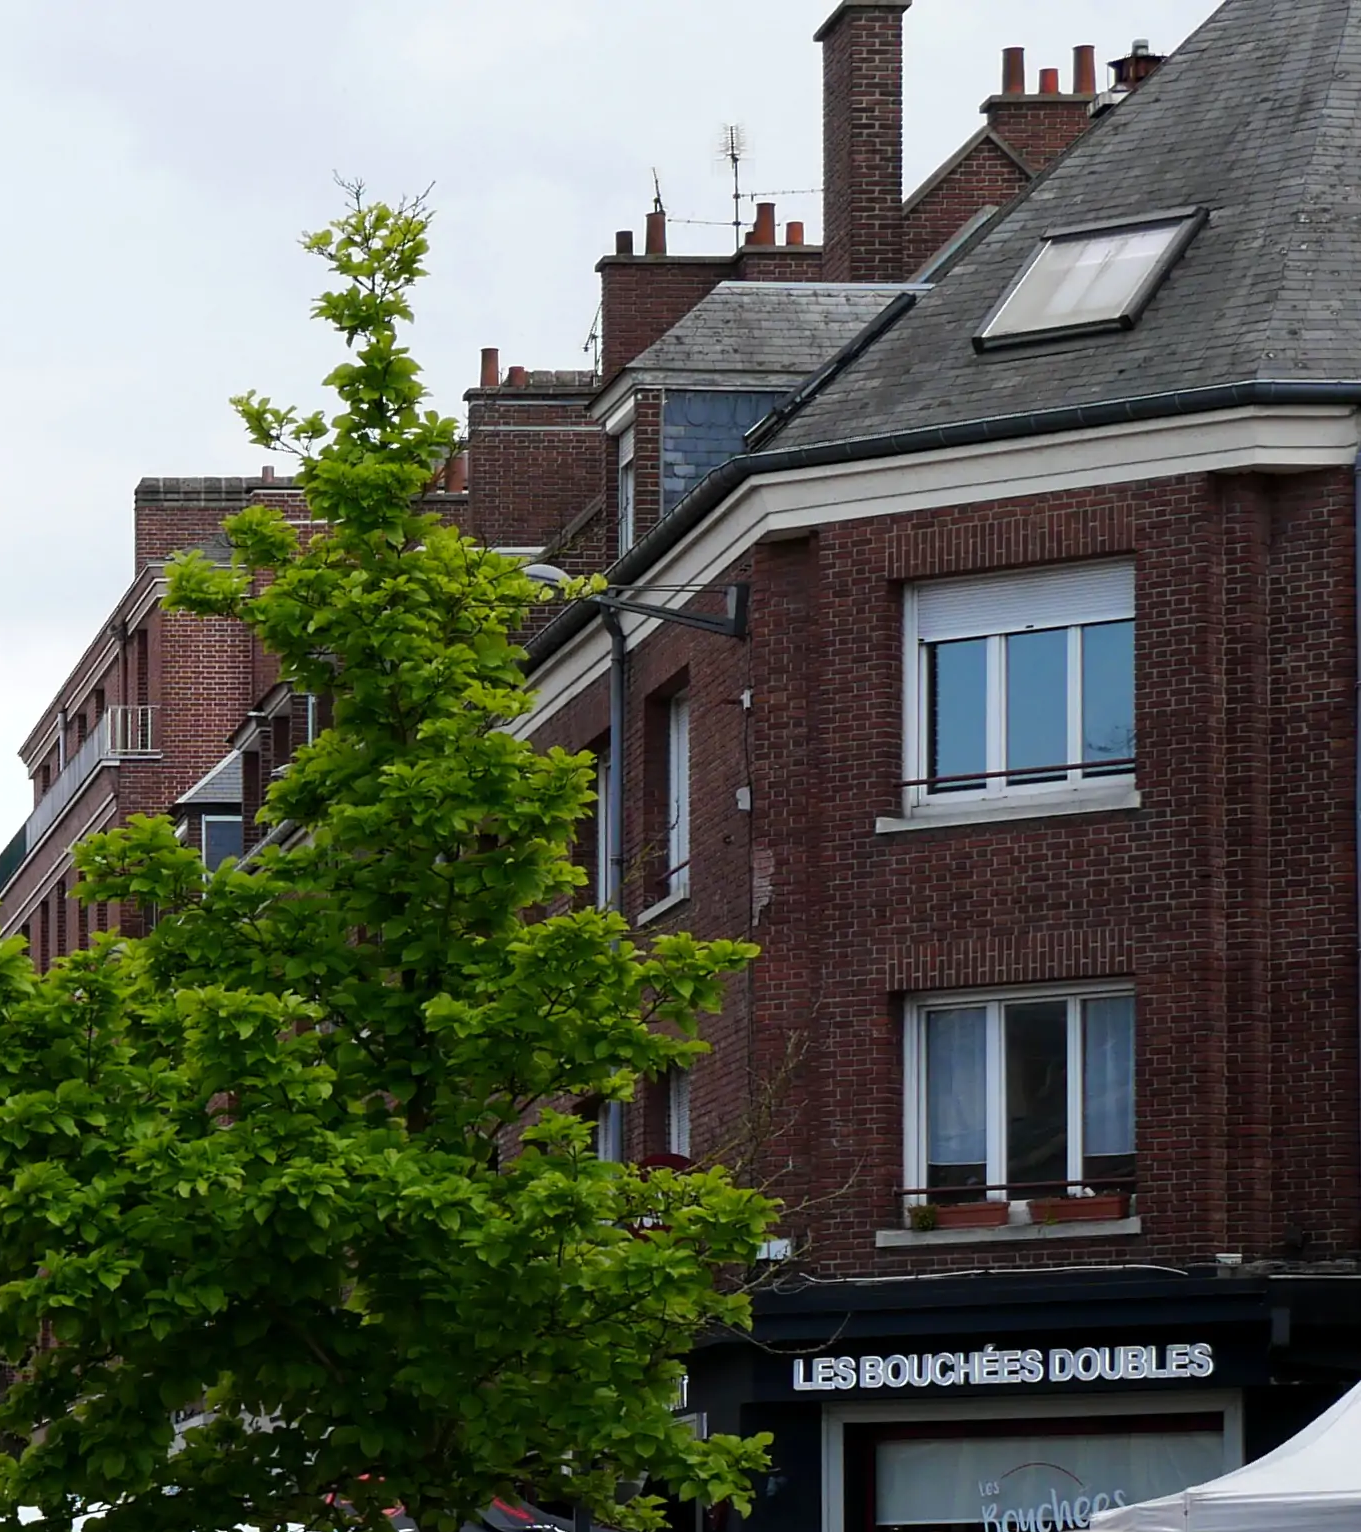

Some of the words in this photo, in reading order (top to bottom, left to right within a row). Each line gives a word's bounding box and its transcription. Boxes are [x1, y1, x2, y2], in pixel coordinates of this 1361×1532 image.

[793, 1356, 856, 1391] LES
[860, 1343, 1044, 1389] BOUCHÉES
[1048, 1342, 1215, 1383] DOUBLES
[978, 1480, 1000, 1497] Les
